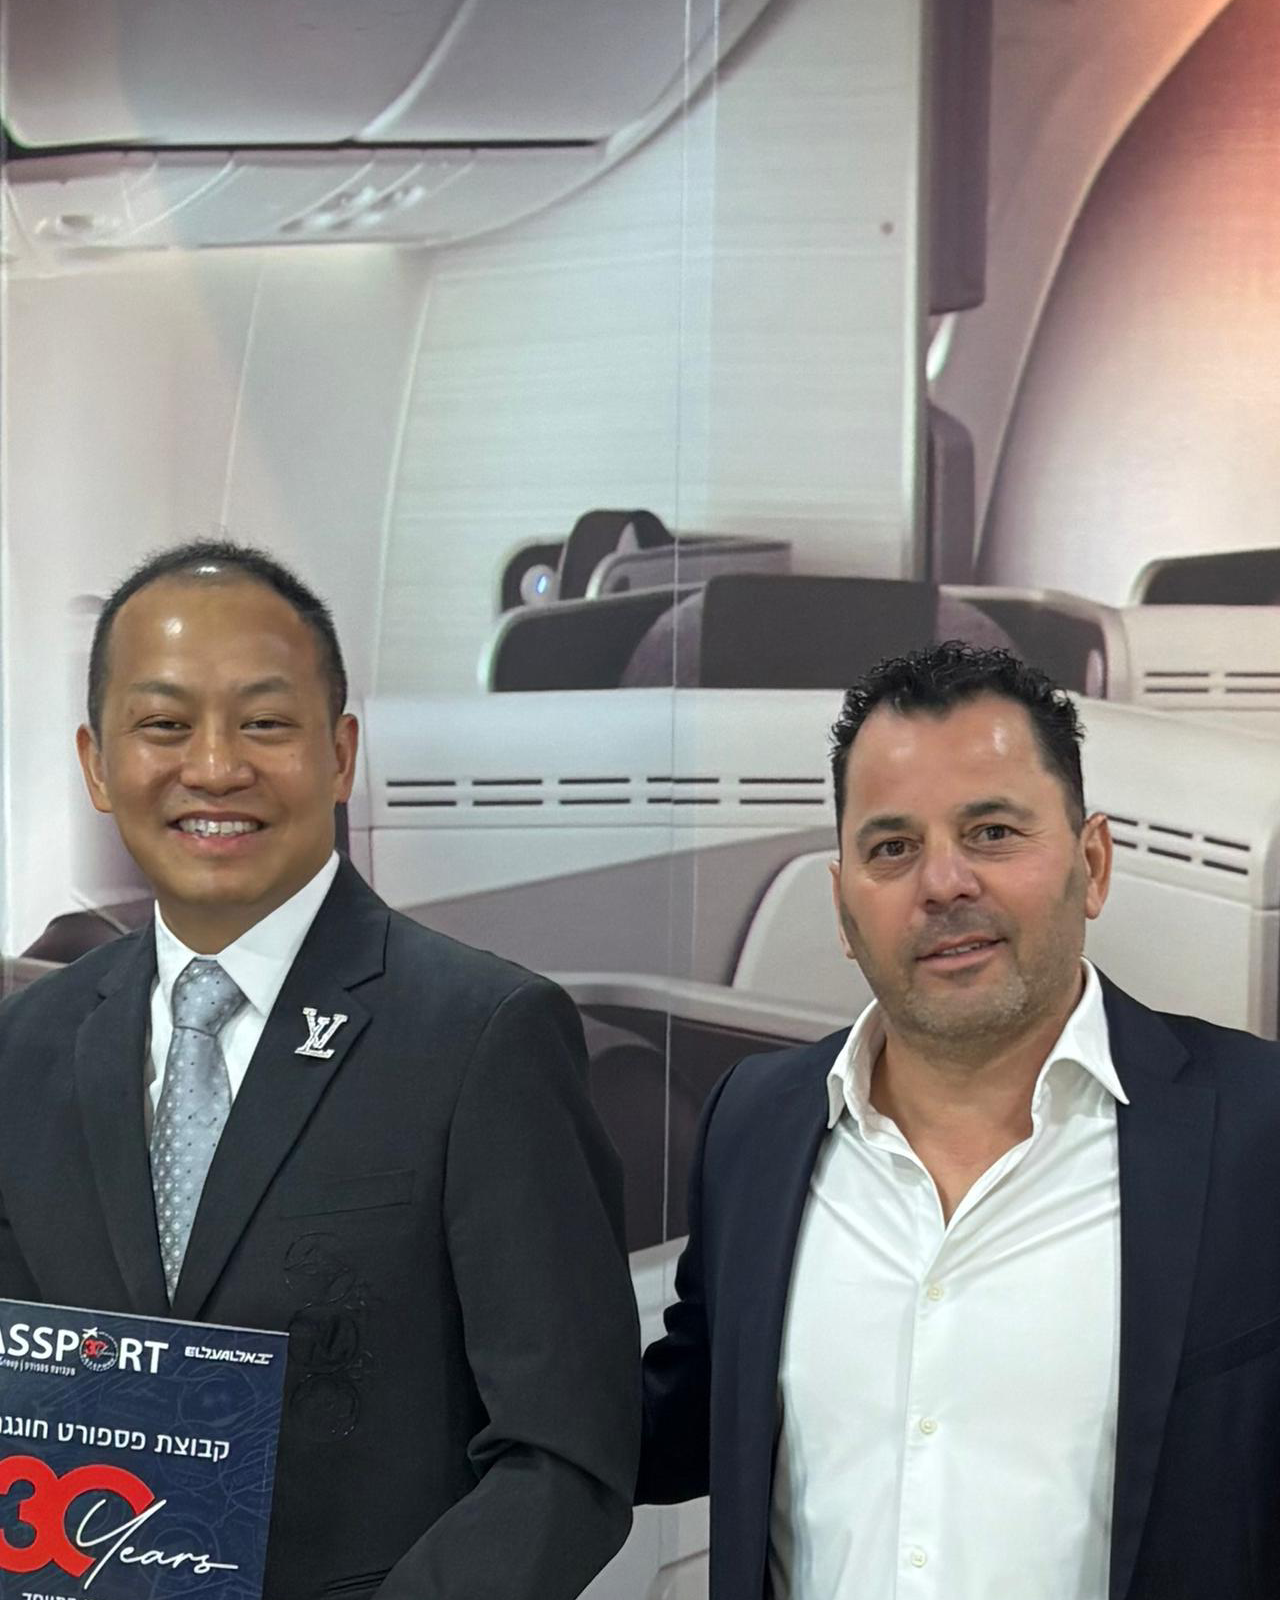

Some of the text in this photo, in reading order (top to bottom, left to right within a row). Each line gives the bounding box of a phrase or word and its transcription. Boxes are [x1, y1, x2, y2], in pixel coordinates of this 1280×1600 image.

[57, 1422, 146, 1450] פספורט
[154, 1434, 230, 1462] קבוצת
[76, 1498, 239, 1590] Years
